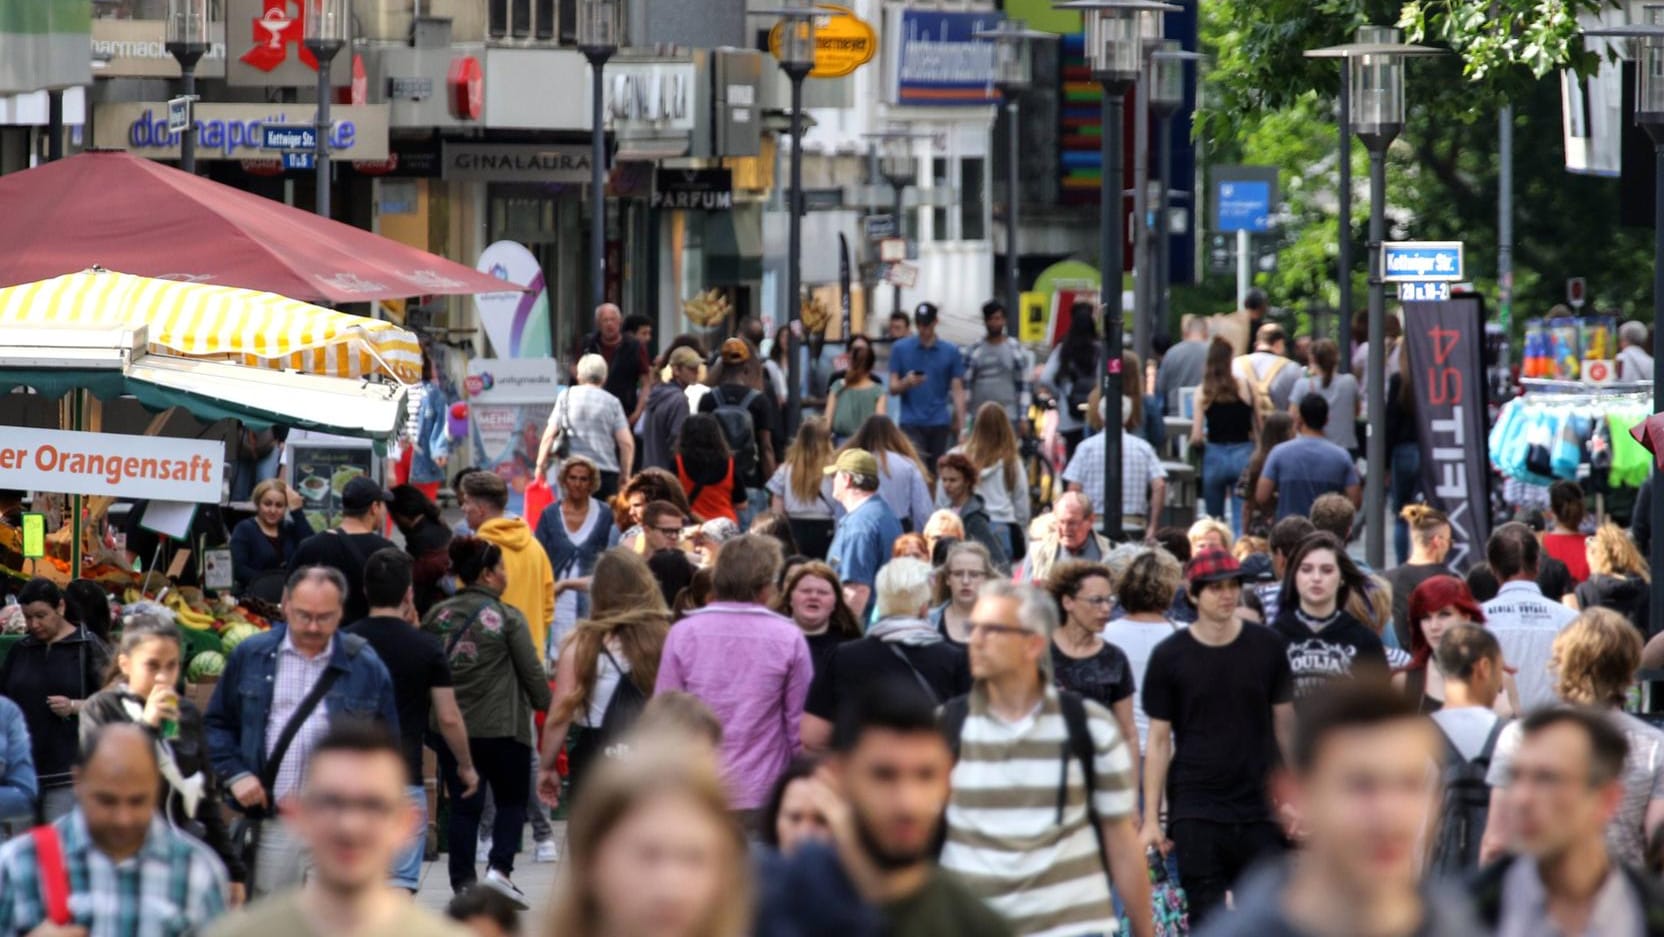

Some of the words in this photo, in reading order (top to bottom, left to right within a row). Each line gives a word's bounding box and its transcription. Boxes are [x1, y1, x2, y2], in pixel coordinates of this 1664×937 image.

[267, 130, 301, 148] Kettwiger
[302, 131, 315, 147] Str.
[455, 153, 591, 170] GINALAURA
[651, 191, 732, 209] PARFUM
[1387, 253, 1434, 276] Kettwiger
[1435, 253, 1455, 271] Str.
[34, 444, 213, 485] Orangensaft
